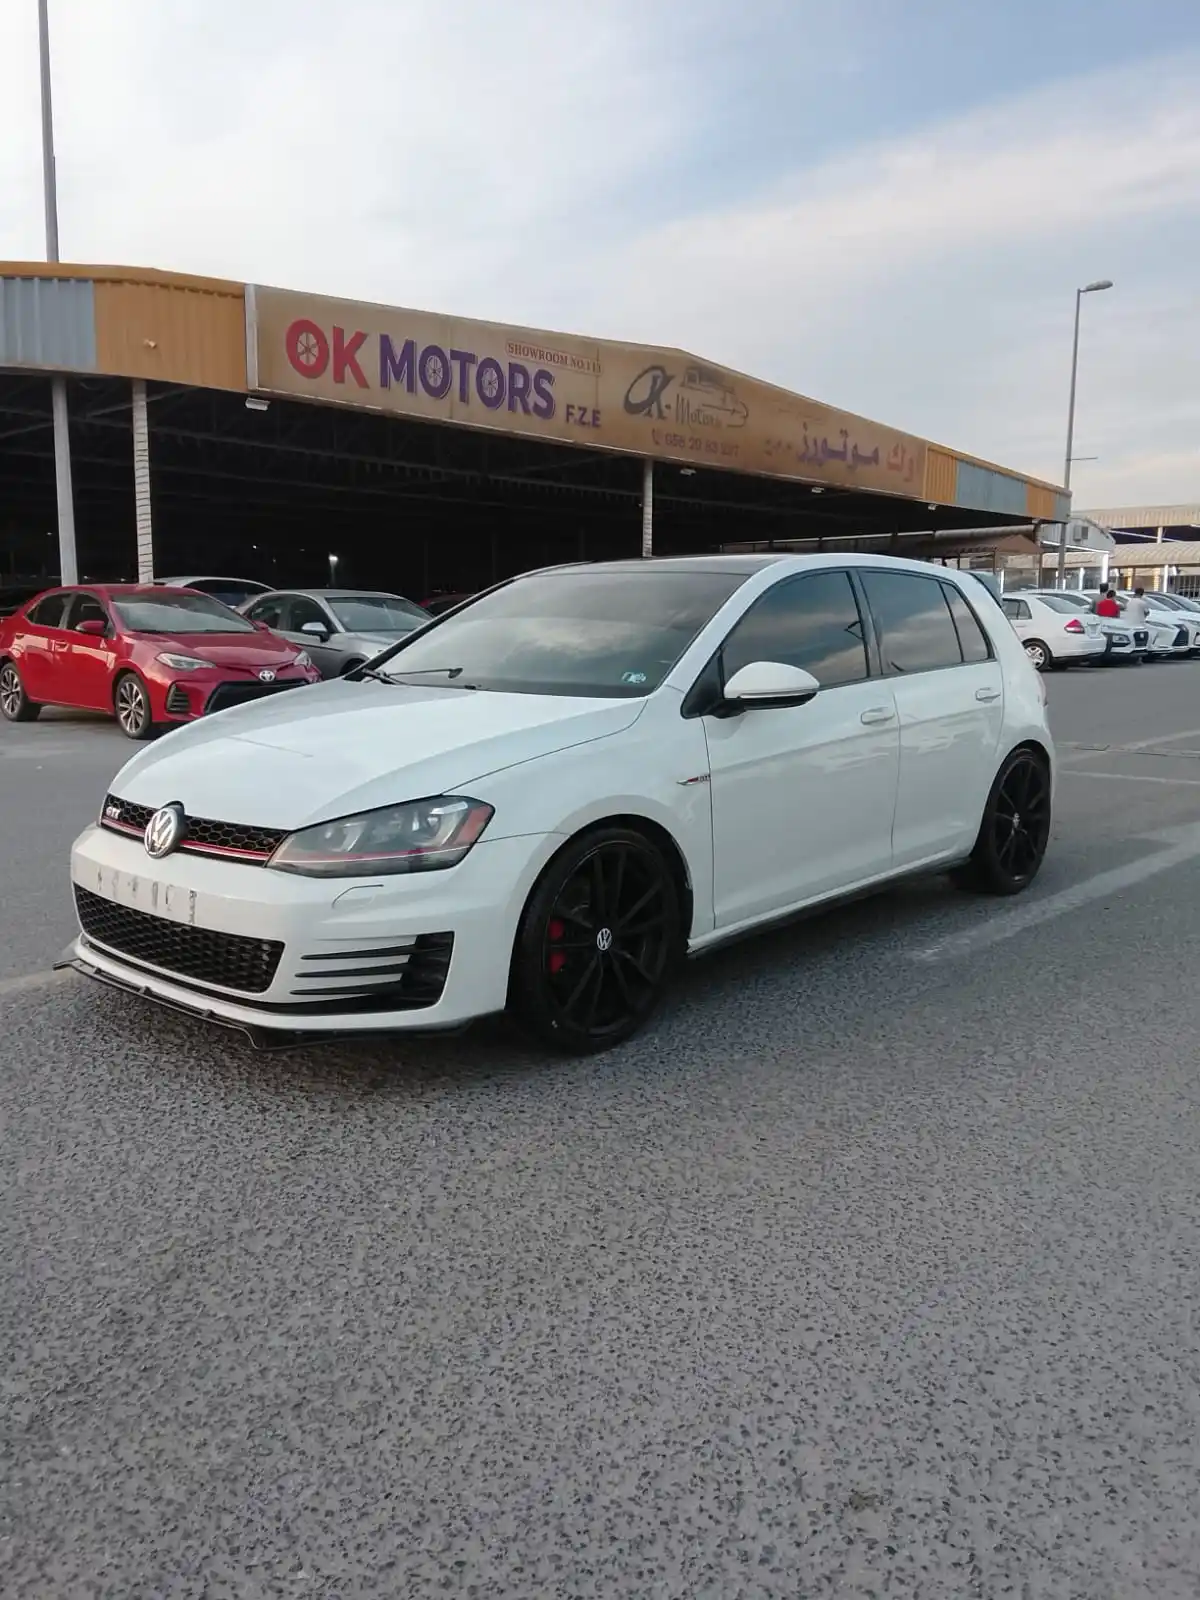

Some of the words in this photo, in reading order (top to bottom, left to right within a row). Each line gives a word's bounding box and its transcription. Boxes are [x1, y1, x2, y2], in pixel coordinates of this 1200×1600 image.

[286, 319, 370, 389] OK
[379, 333, 556, 420] MOTORS
[508, 342, 568, 365] SHOWROOM
